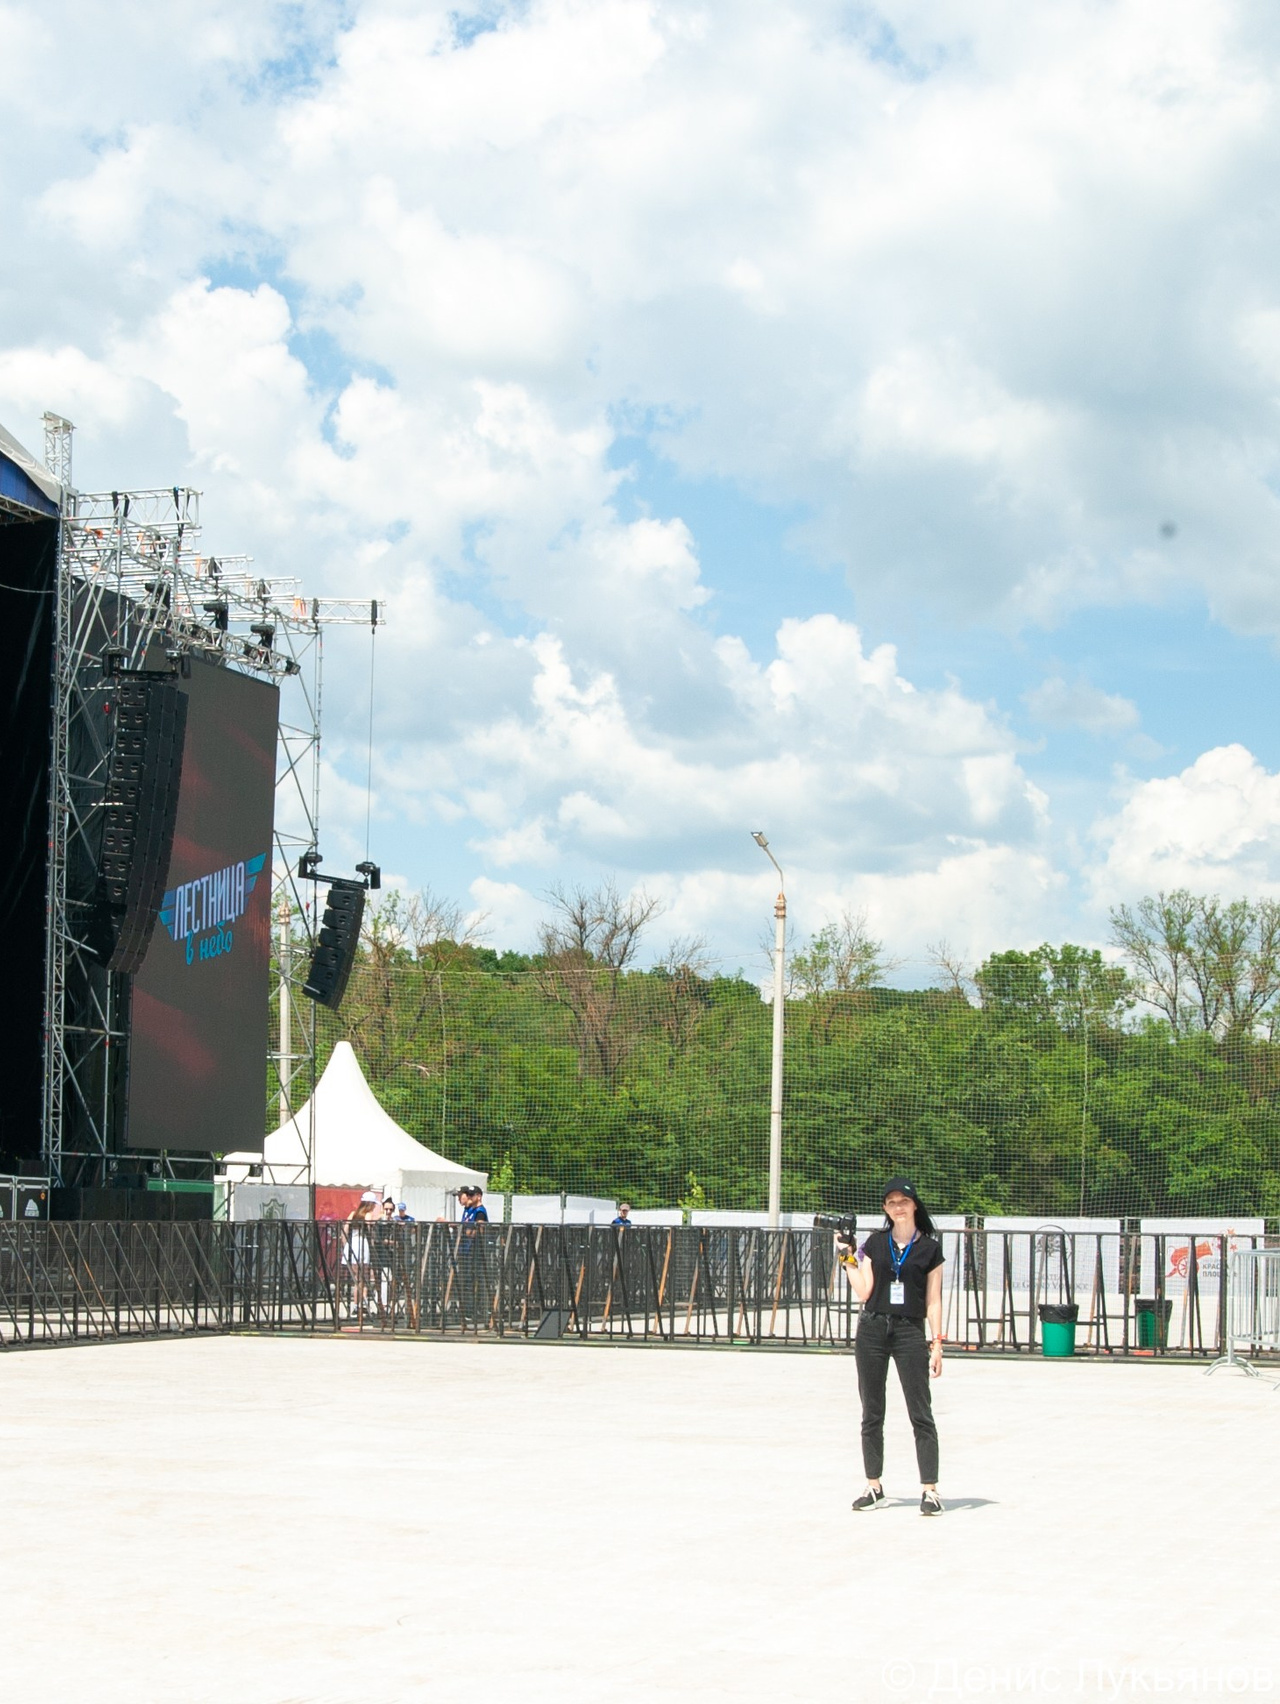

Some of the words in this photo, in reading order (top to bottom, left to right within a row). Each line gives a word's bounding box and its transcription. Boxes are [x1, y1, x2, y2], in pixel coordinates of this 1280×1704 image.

[174, 861, 245, 941] ЛЕСТНИЦА
[186, 931, 194, 966] в
[200, 921, 233, 960] небо
